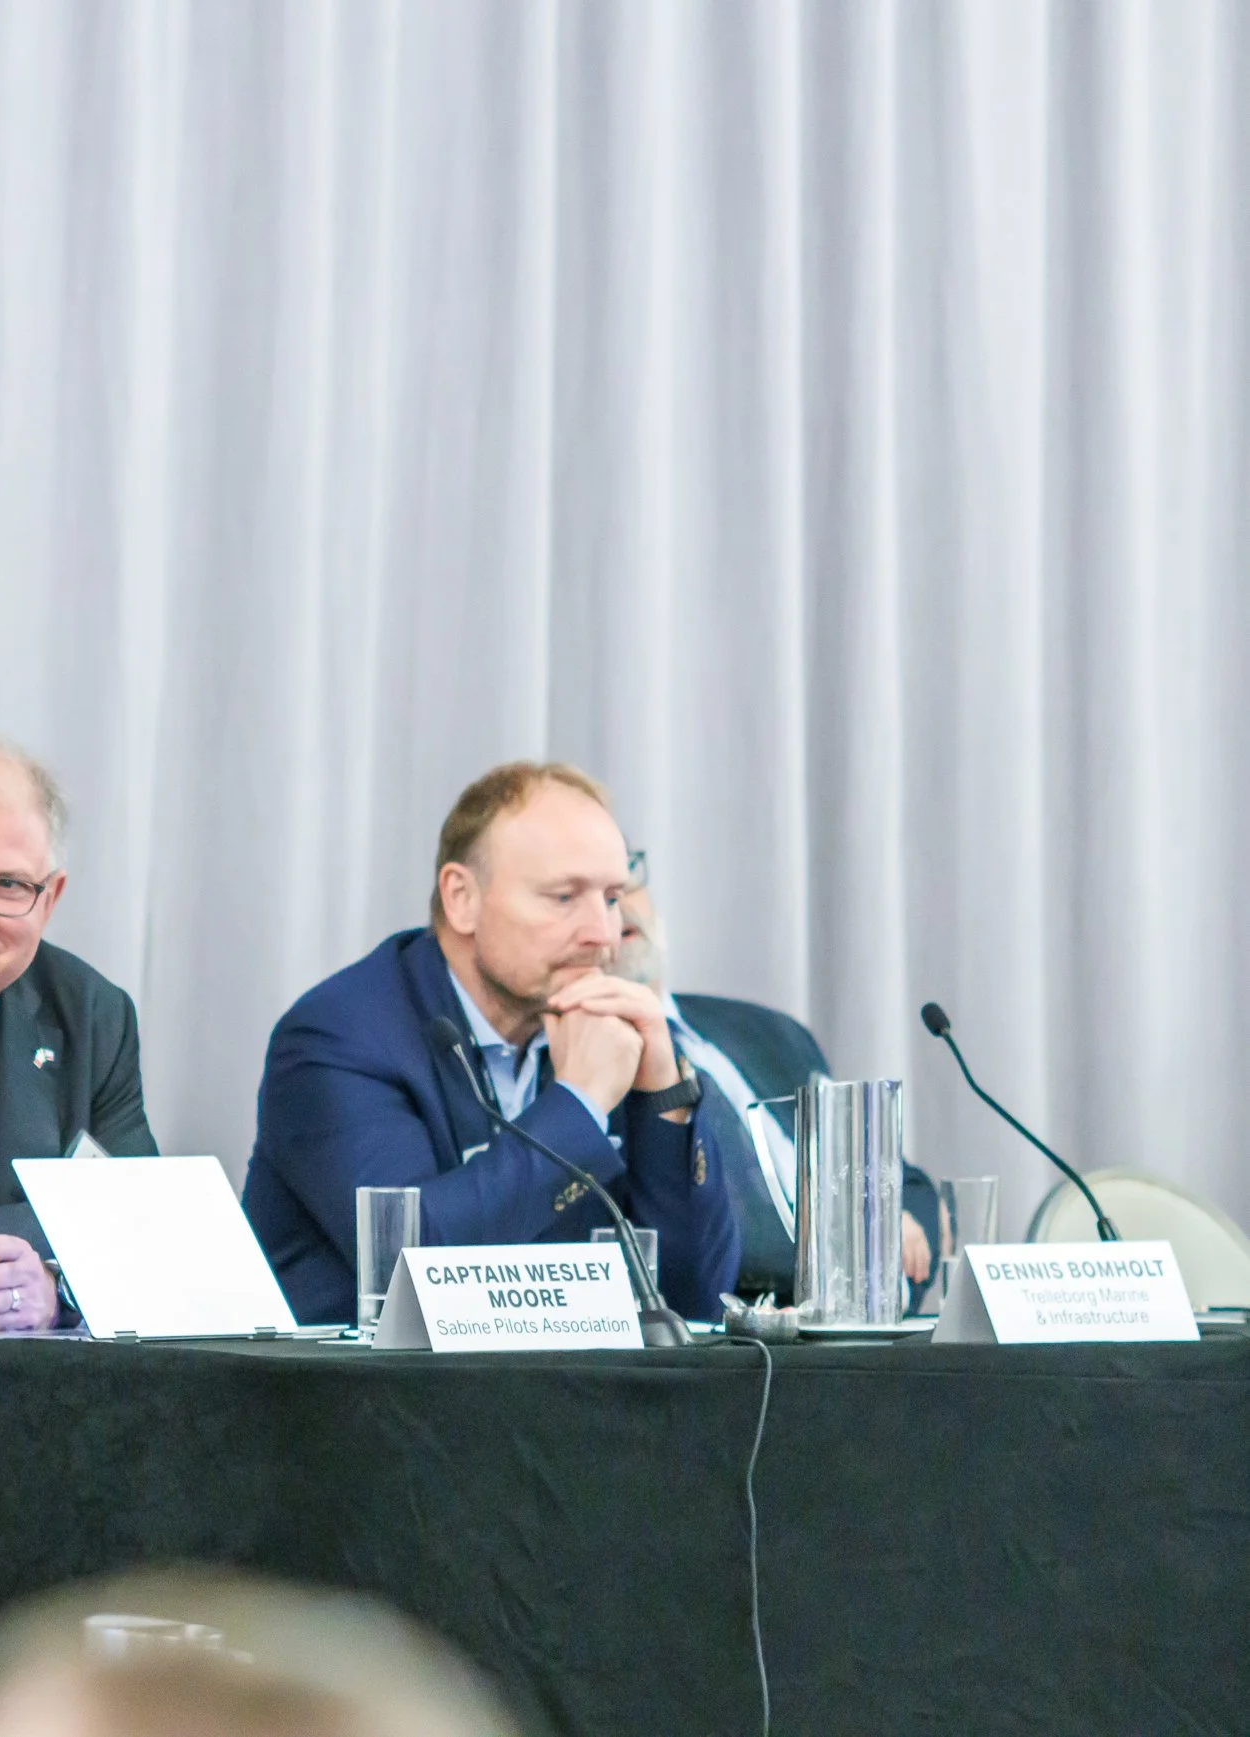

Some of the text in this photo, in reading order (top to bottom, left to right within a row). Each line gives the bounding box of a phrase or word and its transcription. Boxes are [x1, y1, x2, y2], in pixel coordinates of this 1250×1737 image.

[426, 1262, 611, 1285] CAPTAIN WESLEY
[986, 1260, 1164, 1280] DENNIS BOMHOLT
[488, 1289, 567, 1308] MOORE
[1022, 1287, 1150, 1306] Trelleborg Marine
[436, 1316, 630, 1336] Sabine Pilots Association
[1036, 1309, 1150, 1325] & Infrastructure
